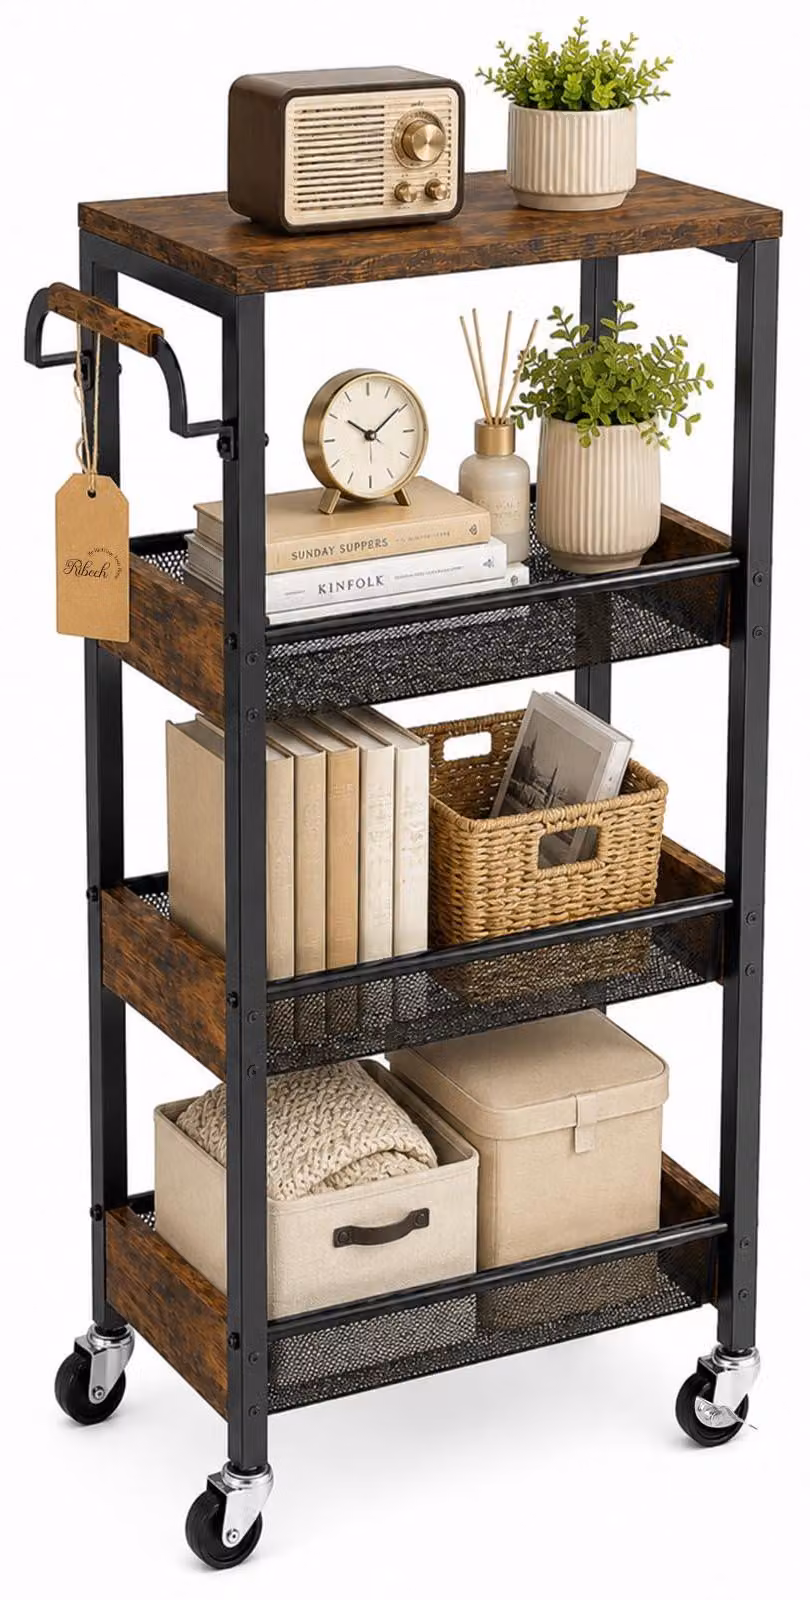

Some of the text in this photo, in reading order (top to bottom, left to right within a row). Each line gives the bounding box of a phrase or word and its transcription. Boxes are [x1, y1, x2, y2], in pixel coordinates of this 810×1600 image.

[291, 538, 388, 561] SUNDAY SUPPERS
[318, 575, 384, 594] KINFOLK
